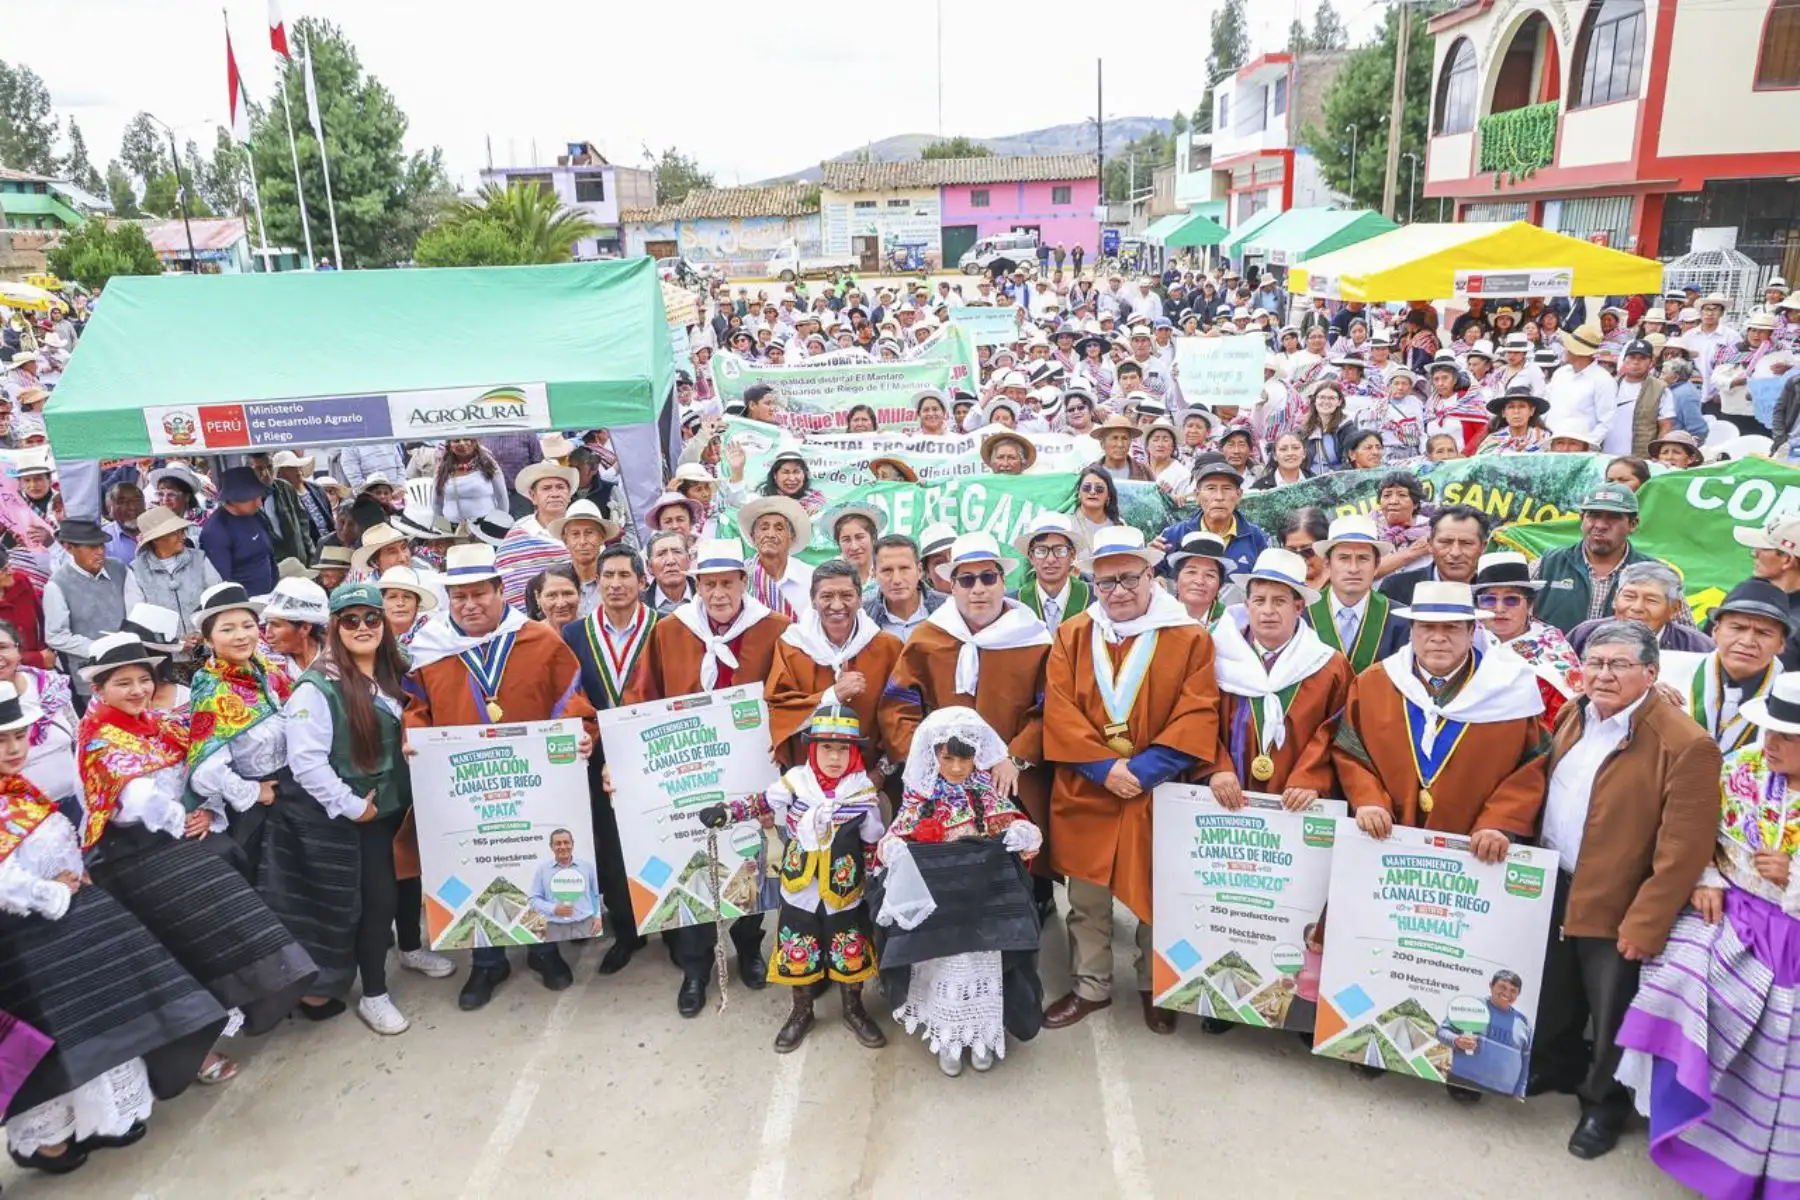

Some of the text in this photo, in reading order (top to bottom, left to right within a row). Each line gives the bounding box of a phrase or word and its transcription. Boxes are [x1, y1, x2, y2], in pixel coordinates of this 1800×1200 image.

[866, 373, 905, 381] Mantaro
[250, 404, 304, 414] Ministerio
[206, 418, 241, 434] PERÚ
[252, 412, 363, 428] de Desarrollo Agrario
[255, 431, 294, 442] y Riego
[1443, 482, 1514, 519] SAN
[642, 719, 699, 742] MANTENIMIENTO
[647, 725, 718, 757] AMPLIACIÓN
[451, 749, 512, 764] MANTENIMIENTO
[649, 749, 690, 773] CANALES
[691, 747, 703, 761] DE
[703, 742, 731, 758] RIEGO
[455, 755, 529, 782] AMPLIACIÓN
[456, 779, 500, 796] CANALES
[500, 777, 513, 790] DE
[514, 775, 542, 788] RIEGO
[1198, 817, 1263, 829] MANTENIMIENTO
[490, 835, 544, 847] productores
[1200, 828, 1281, 850] AMPLIACIÓN
[475, 856, 492, 864] 100
[1198, 845, 1246, 861] CANALES
[1247, 849, 1260, 862] DE
[1262, 851, 1293, 867] RIEGO
[1385, 856, 1459, 872] MANTENIMIENTO
[1385, 869, 1479, 897] AMPLIACIÓN
[1381, 886, 1436, 905] CANALES
[1438, 892, 1452, 907] DE
[1454, 895, 1491, 915] RIEGO
[1229, 908, 1291, 924] productores
[1228, 927, 1277, 942] Hectáreas
[1392, 951, 1484, 976] 200 productores
[1406, 973, 1461, 992] Hectáreas
